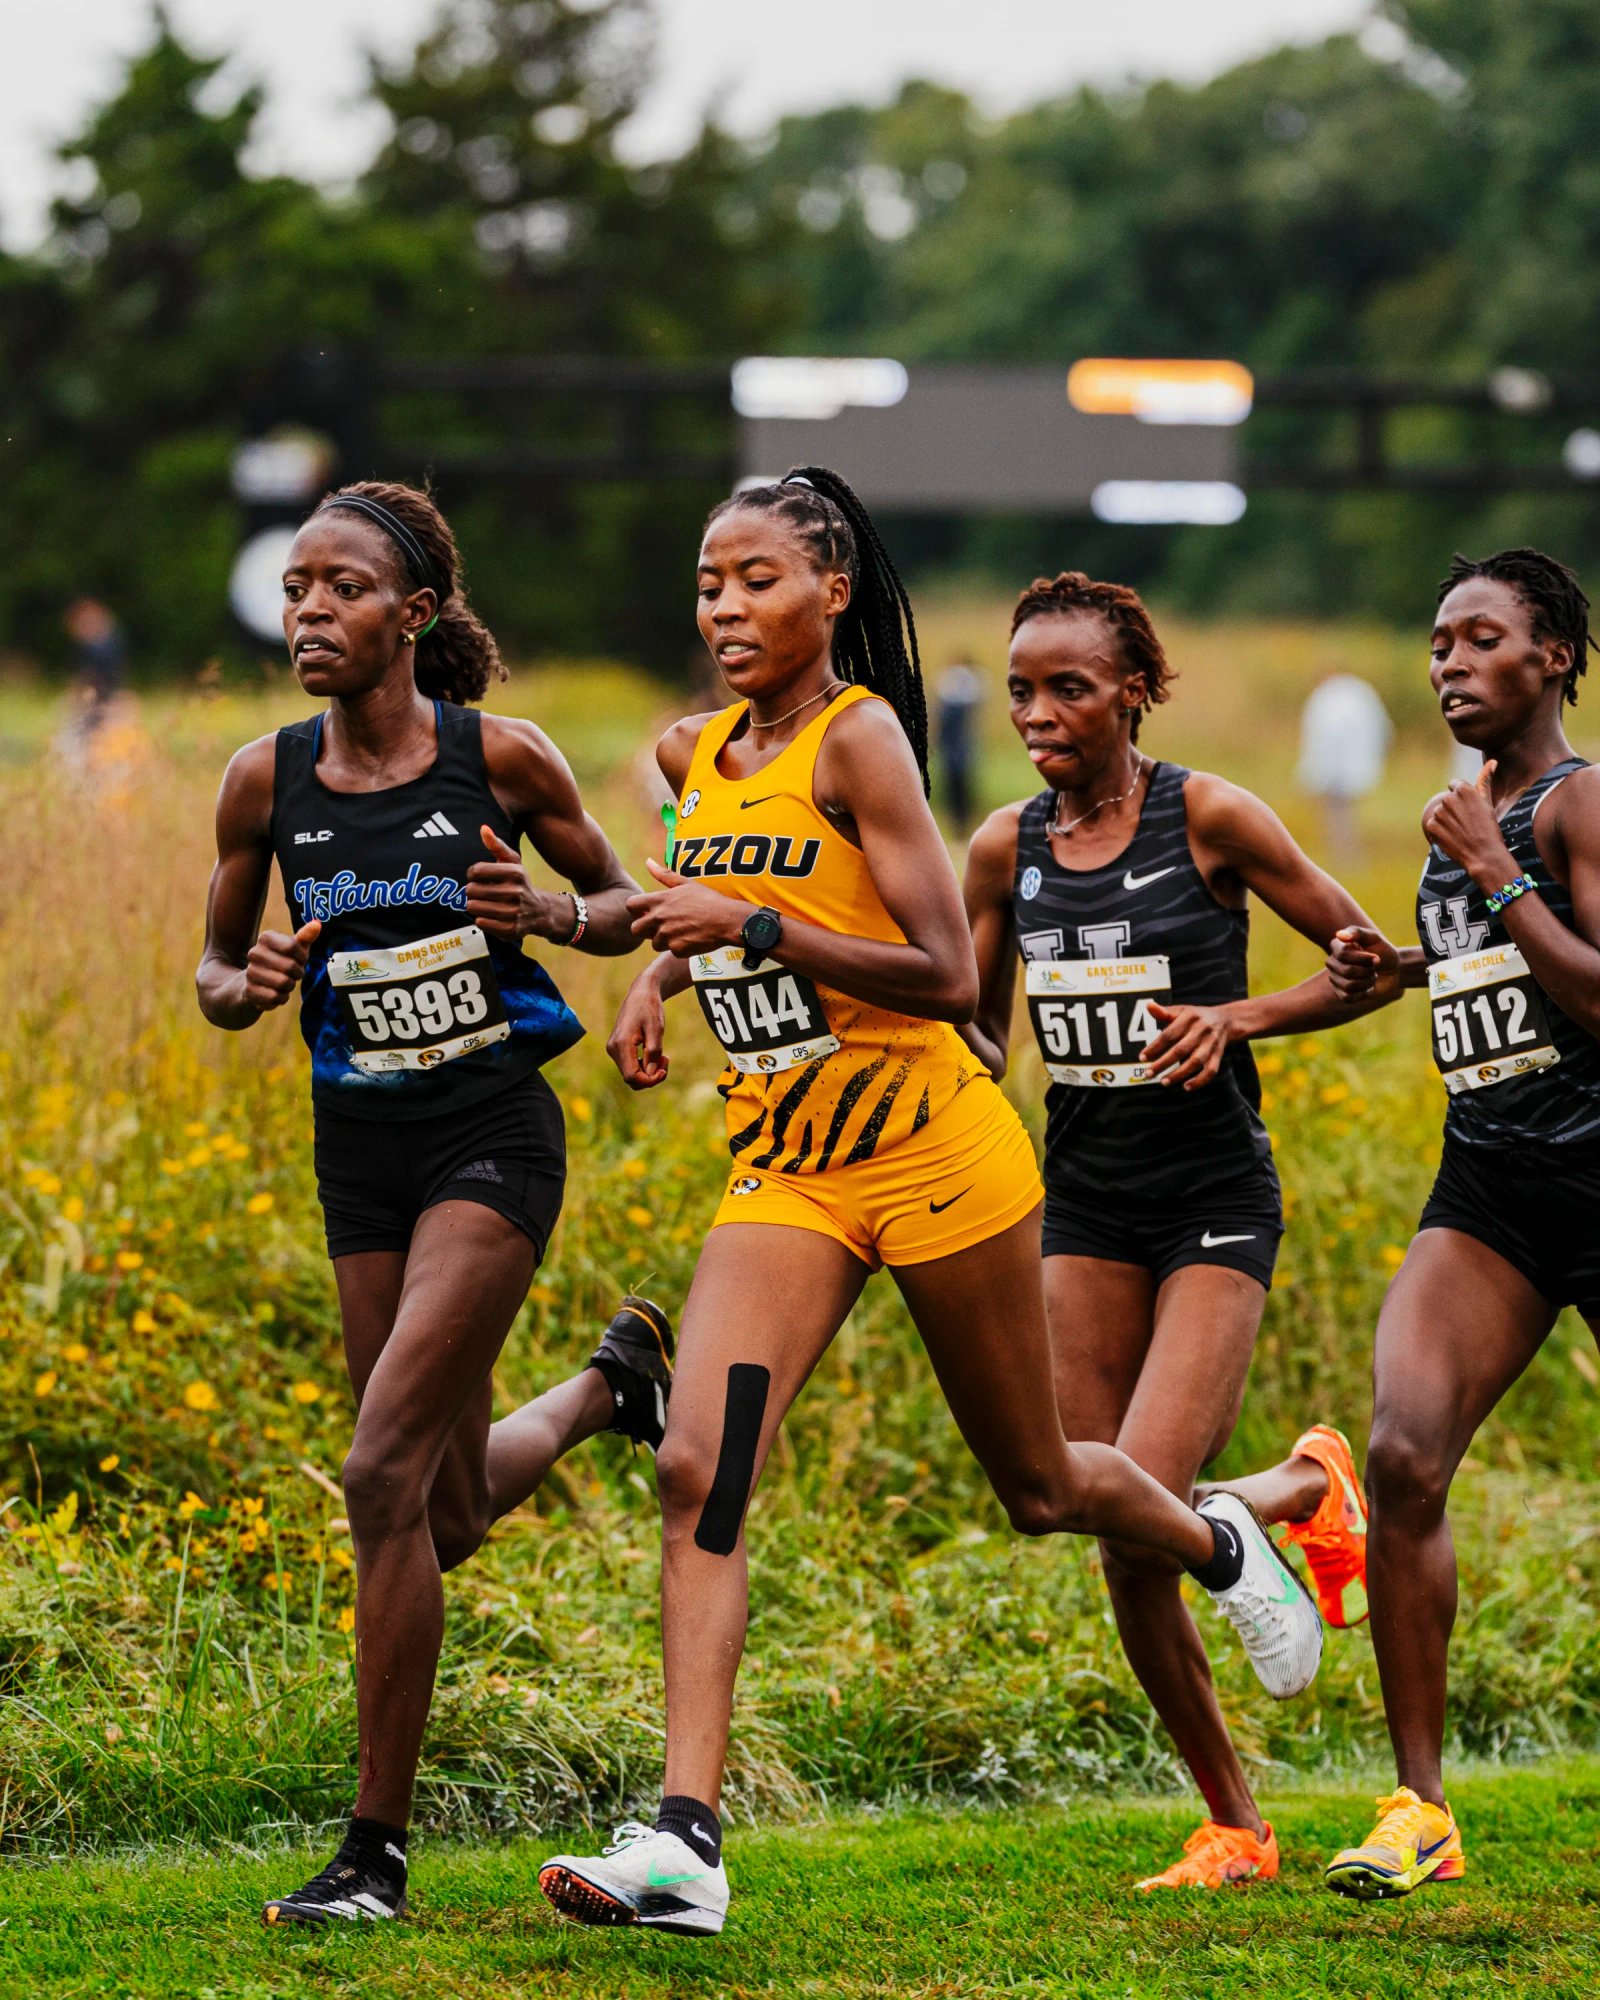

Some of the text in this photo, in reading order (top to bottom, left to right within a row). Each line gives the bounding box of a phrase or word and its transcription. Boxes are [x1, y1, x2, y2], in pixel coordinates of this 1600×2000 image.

[671, 833, 823, 880] IZZOU
[294, 862, 469, 925] Islanders
[397, 935, 463, 963] GANS CREEK
[349, 970, 488, 1042] 5393
[704, 975, 812, 1044] 5144
[1038, 998, 1162, 1057] 5114
[1433, 986, 1537, 1063] 5112
[463, 1036, 480, 1048] CPS
[792, 1046, 809, 1058] CPS
[1515, 1057, 1532, 1067] CPS
[1134, 1068, 1145, 1077] CP
